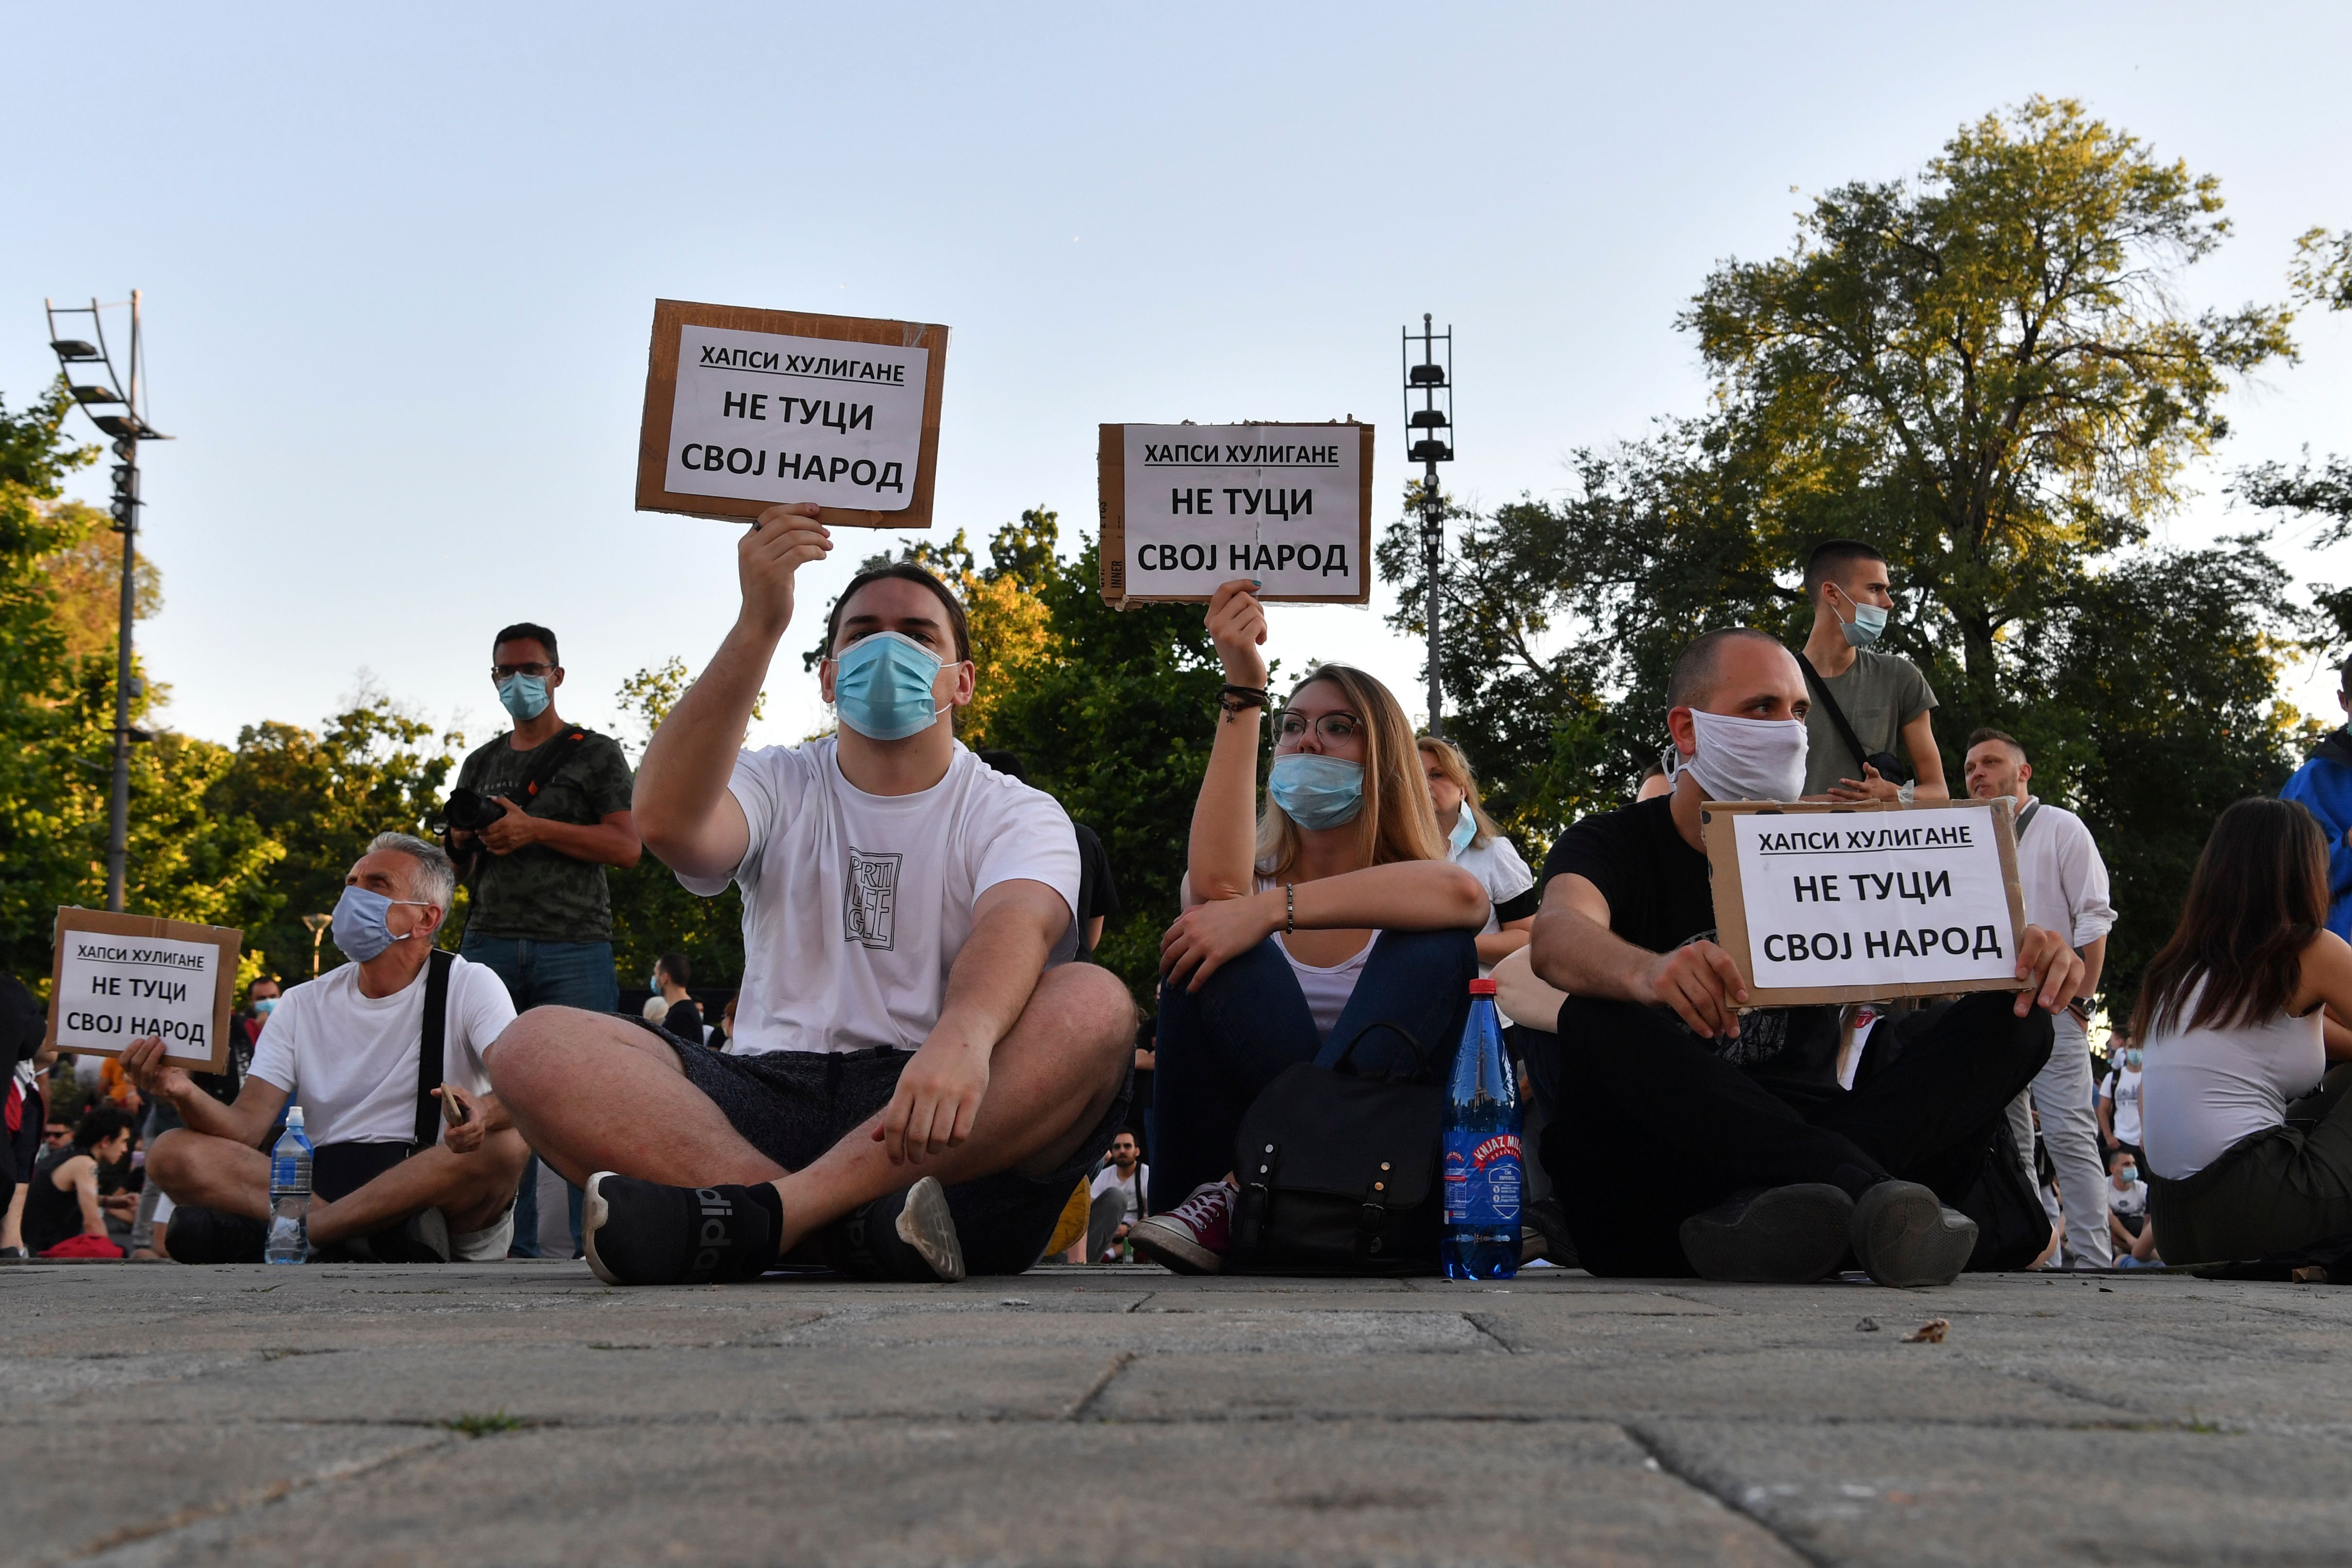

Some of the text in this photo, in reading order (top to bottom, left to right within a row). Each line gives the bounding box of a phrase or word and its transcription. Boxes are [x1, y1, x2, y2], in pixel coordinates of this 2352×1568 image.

[700, 345, 905, 382] ХАПСИ ХУЛИГАНЕ
[723, 391, 873, 435] НЕ ТУЦИ
[681, 443, 766, 476] СВОЈ
[778, 452, 903, 493] НАРОД
[1144, 444, 1338, 463] ХАПСИ ХУЛИГАНЕ
[1172, 488, 1312, 522] НЕ ТУЦИ
[1111, 561, 1122, 588] INNER
[1138, 544, 1349, 577] СВОЈ НАРОД
[1758, 826, 1972, 851] ХАПСИ ХУЛИГАНЕ
[1794, 870, 1951, 905] НЕ ТУЦИ
[77, 944, 204, 968] ХАПСИ ХУЛИГАНЕ
[1764, 925, 2003, 962] СВОЈ НАРОД
[92, 976, 186, 1004] НЕ ТУЦИ
[67, 1012, 205, 1047] СВОЈ НАРОД
[1474, 1136, 1505, 1161] KNJAZ
[692, 1188, 733, 1271] dida
